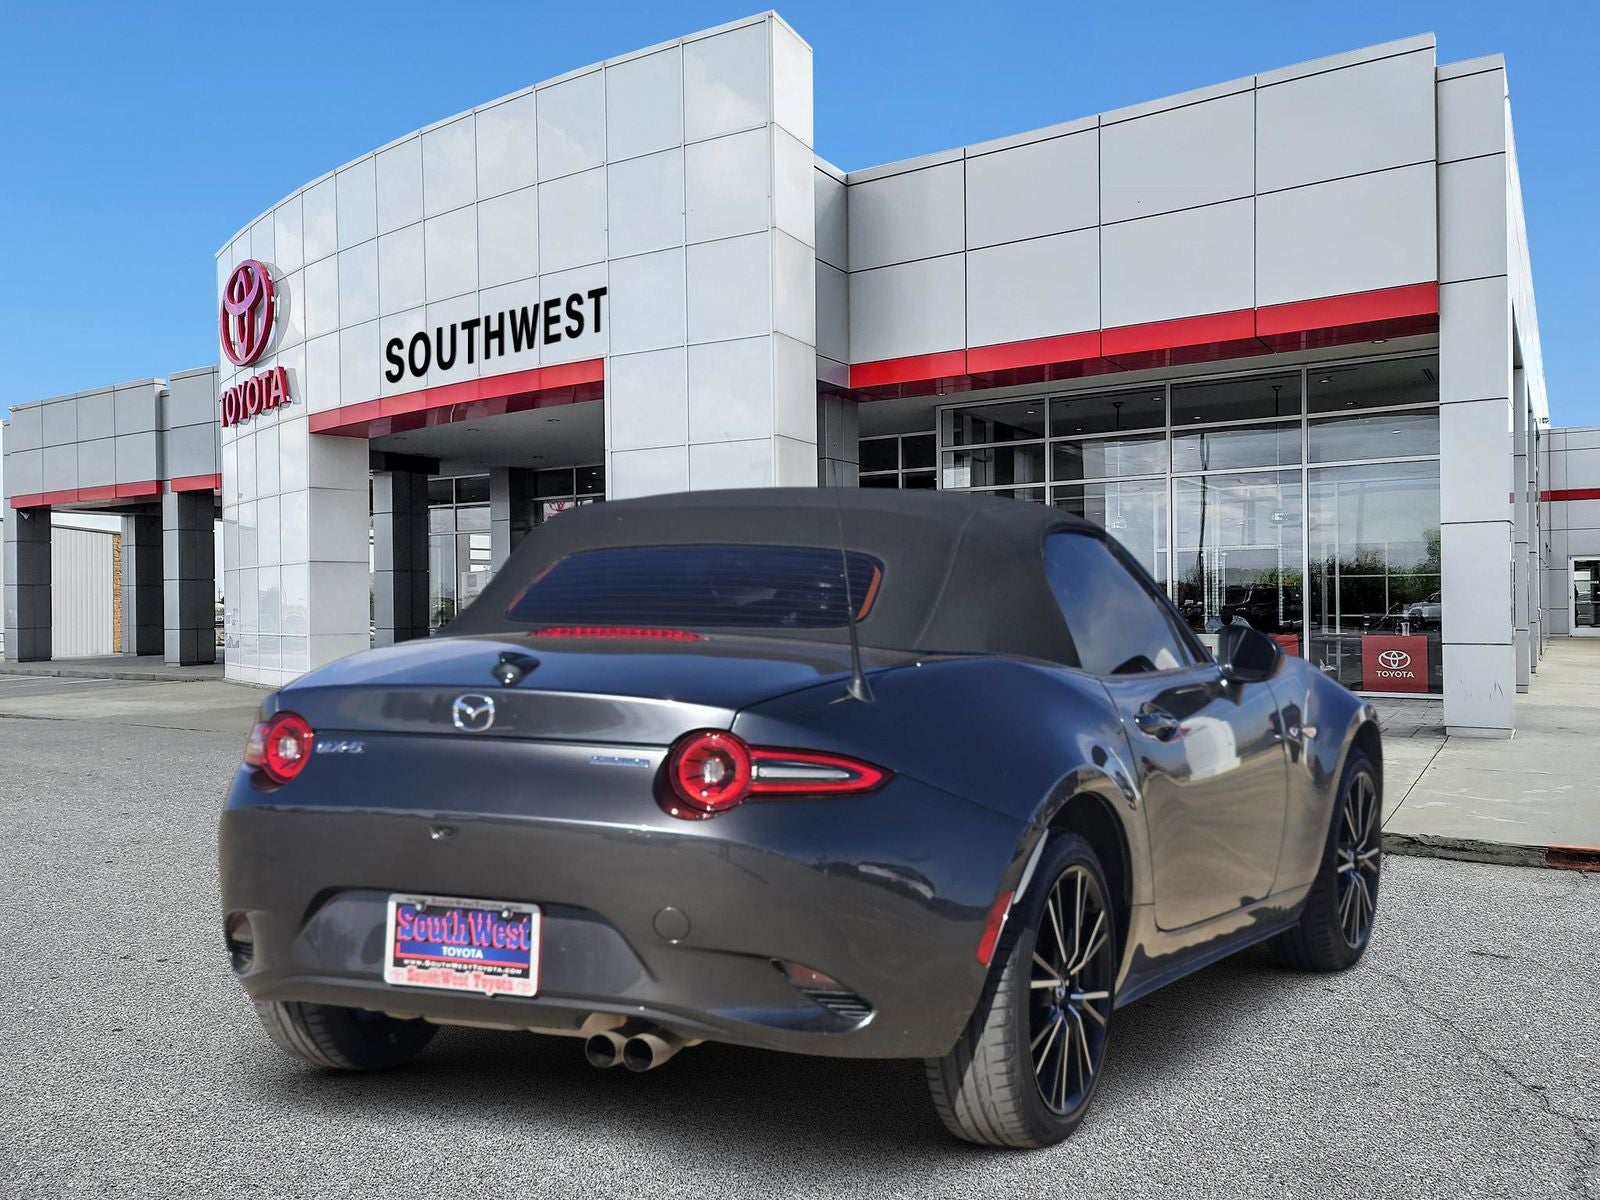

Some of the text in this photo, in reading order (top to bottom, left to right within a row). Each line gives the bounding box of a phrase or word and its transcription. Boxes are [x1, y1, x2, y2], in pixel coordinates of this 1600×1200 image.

[385, 286, 608, 384] SOUTHWEST
[218, 366, 291, 428] TOYOTA
[1376, 670, 1415, 678] TOYOTA
[442, 946, 483, 960] TOYOTA
